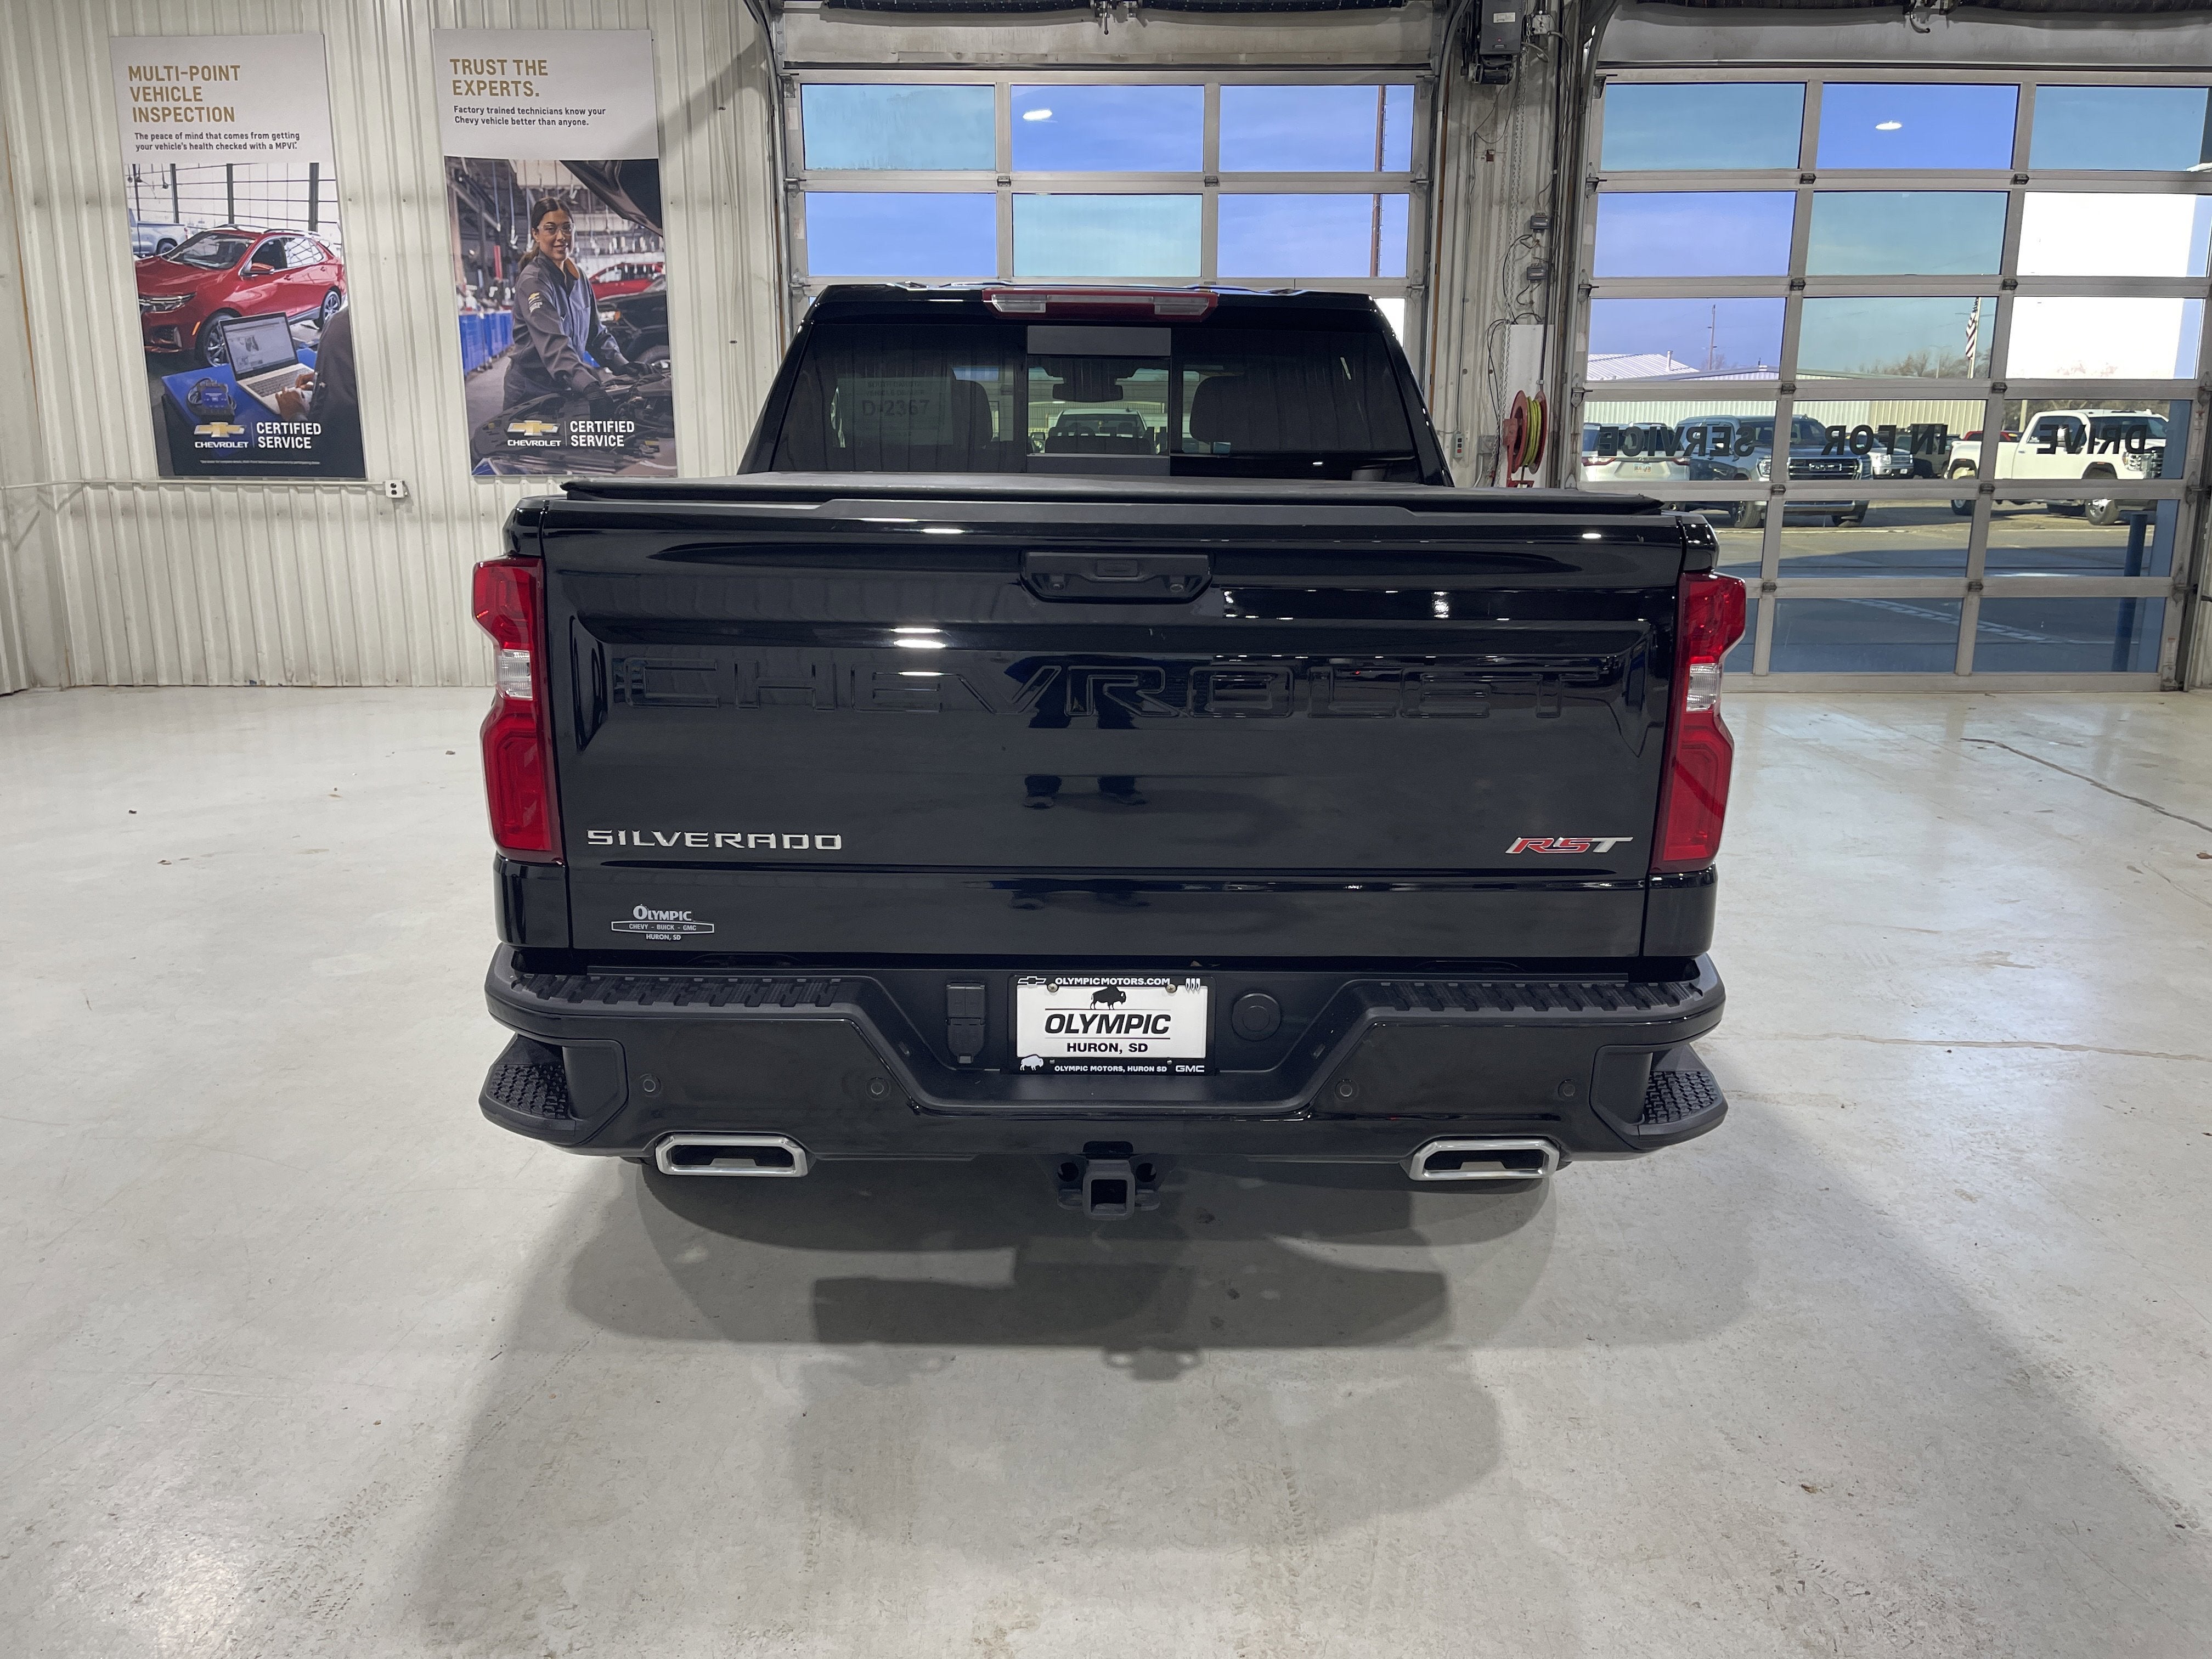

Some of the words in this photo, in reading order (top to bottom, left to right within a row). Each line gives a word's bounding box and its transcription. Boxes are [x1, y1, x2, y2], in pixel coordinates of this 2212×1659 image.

[128, 65, 240, 81] MULTI-POINT
[450, 59, 507, 75] TRUST
[512, 59, 548, 76] THE
[129, 86, 203, 102] VEHICLE
[452, 80, 540, 97] EXPERTS.
[132, 106, 235, 122] INSPECTION
[454, 106, 484, 115] Factory
[517, 106, 562, 115] technicians
[588, 108, 606, 117] your
[455, 116, 478, 125] Chevy
[481, 117, 509, 125] vehicle
[558, 119, 589, 127] anyone.
[151, 133, 173, 142] peace
[272, 132, 300, 141] getting
[136, 143, 153, 152] your
[155, 142, 187, 150] vehicle's
[189, 142, 213, 150] health
[256, 422, 321, 435] CERTIFIED
[569, 420, 635, 433] CERTIFIED
[258, 437, 312, 449] SERVICE
[571, 435, 624, 447] SERVICE
[624, 658, 1599, 719] CHEVROLET
[587, 830, 842, 850] SILVERADO
[1505, 837, 1634, 854] RST
[633, 905, 692, 921] OLYMPIC
[1054, 977, 1170, 986] OLYMPICMOTORS.COM
[1045, 1013, 1171, 1035] OLYMPIC
[1066, 1042, 1123, 1054] HURON,
[1127, 1043, 1148, 1053] SD
